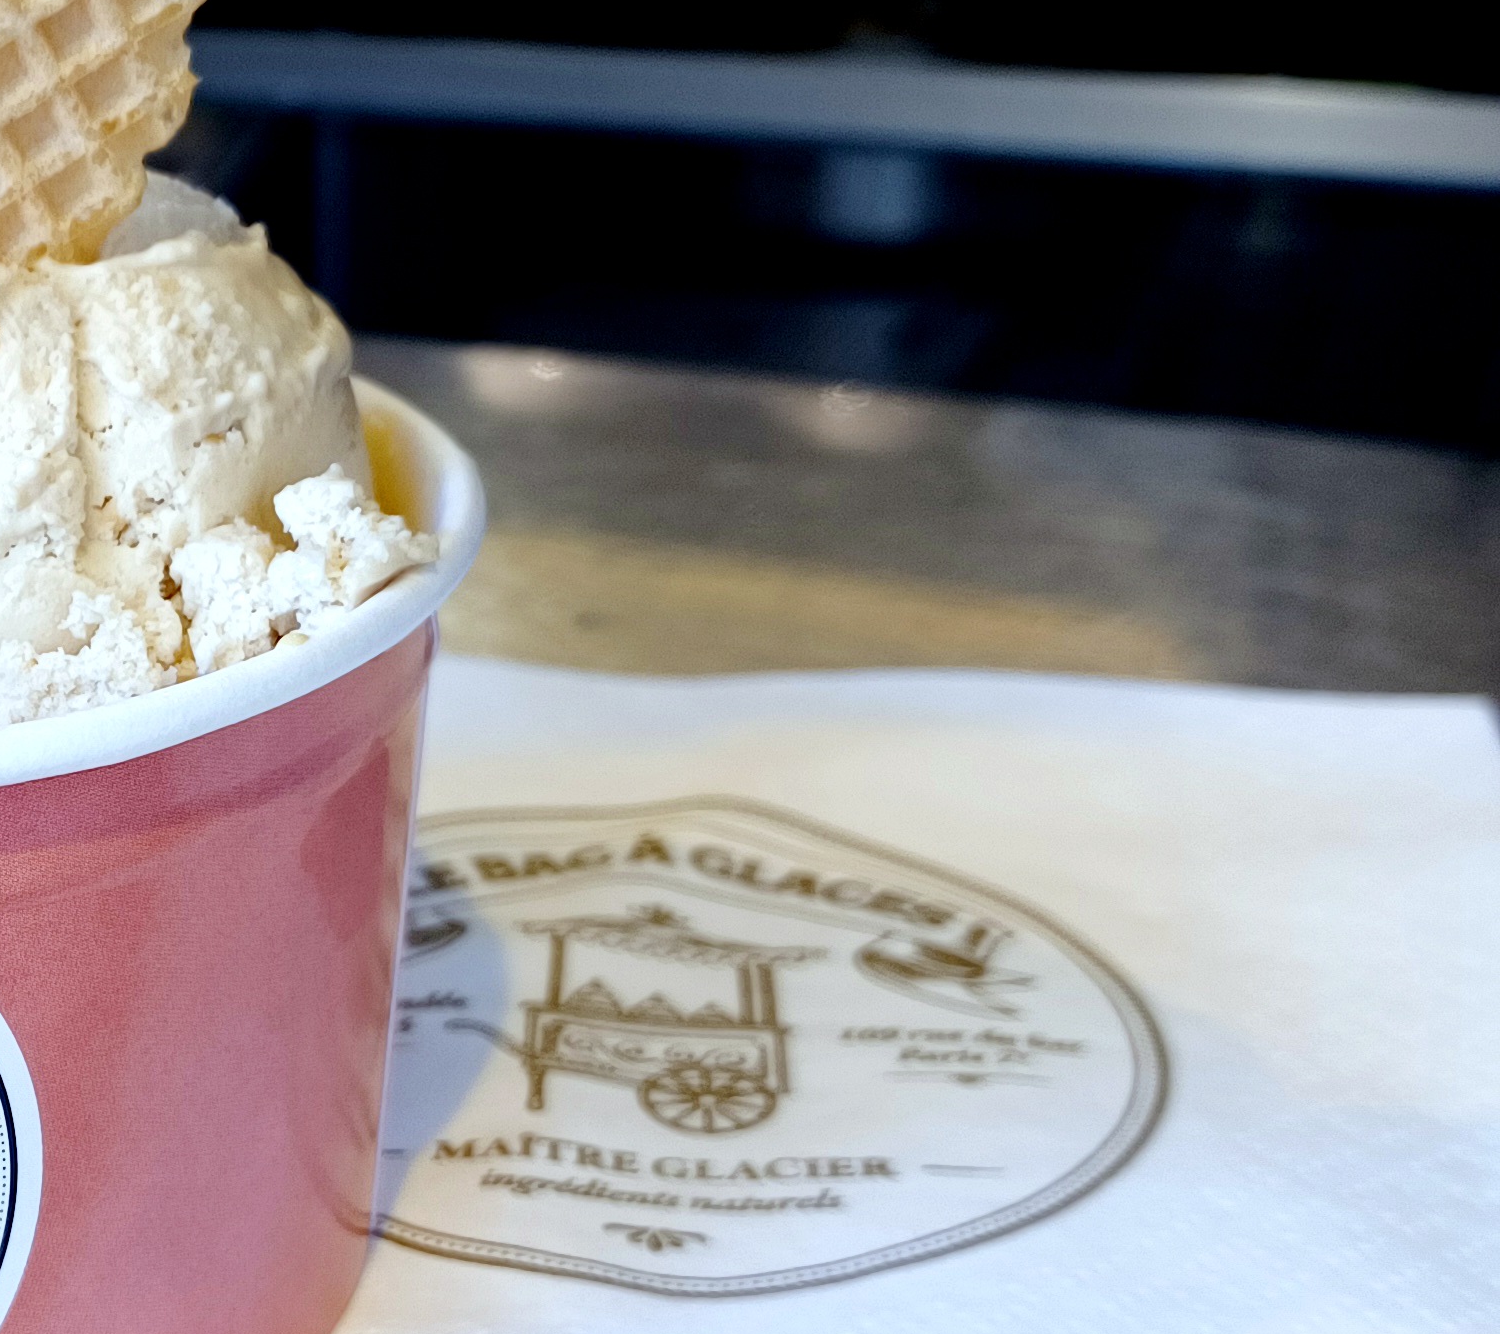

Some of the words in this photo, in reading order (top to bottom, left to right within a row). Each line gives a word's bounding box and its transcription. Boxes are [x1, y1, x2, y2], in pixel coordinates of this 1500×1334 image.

[472, 844, 612, 883] BAC
[689, 845, 956, 927] GLACES
[431, 1132, 640, 1175] MAÎTRE
[650, 1154, 900, 1182] GLACIER
[480, 1168, 682, 1210] ingrédients
[689, 1187, 843, 1213] naturels
